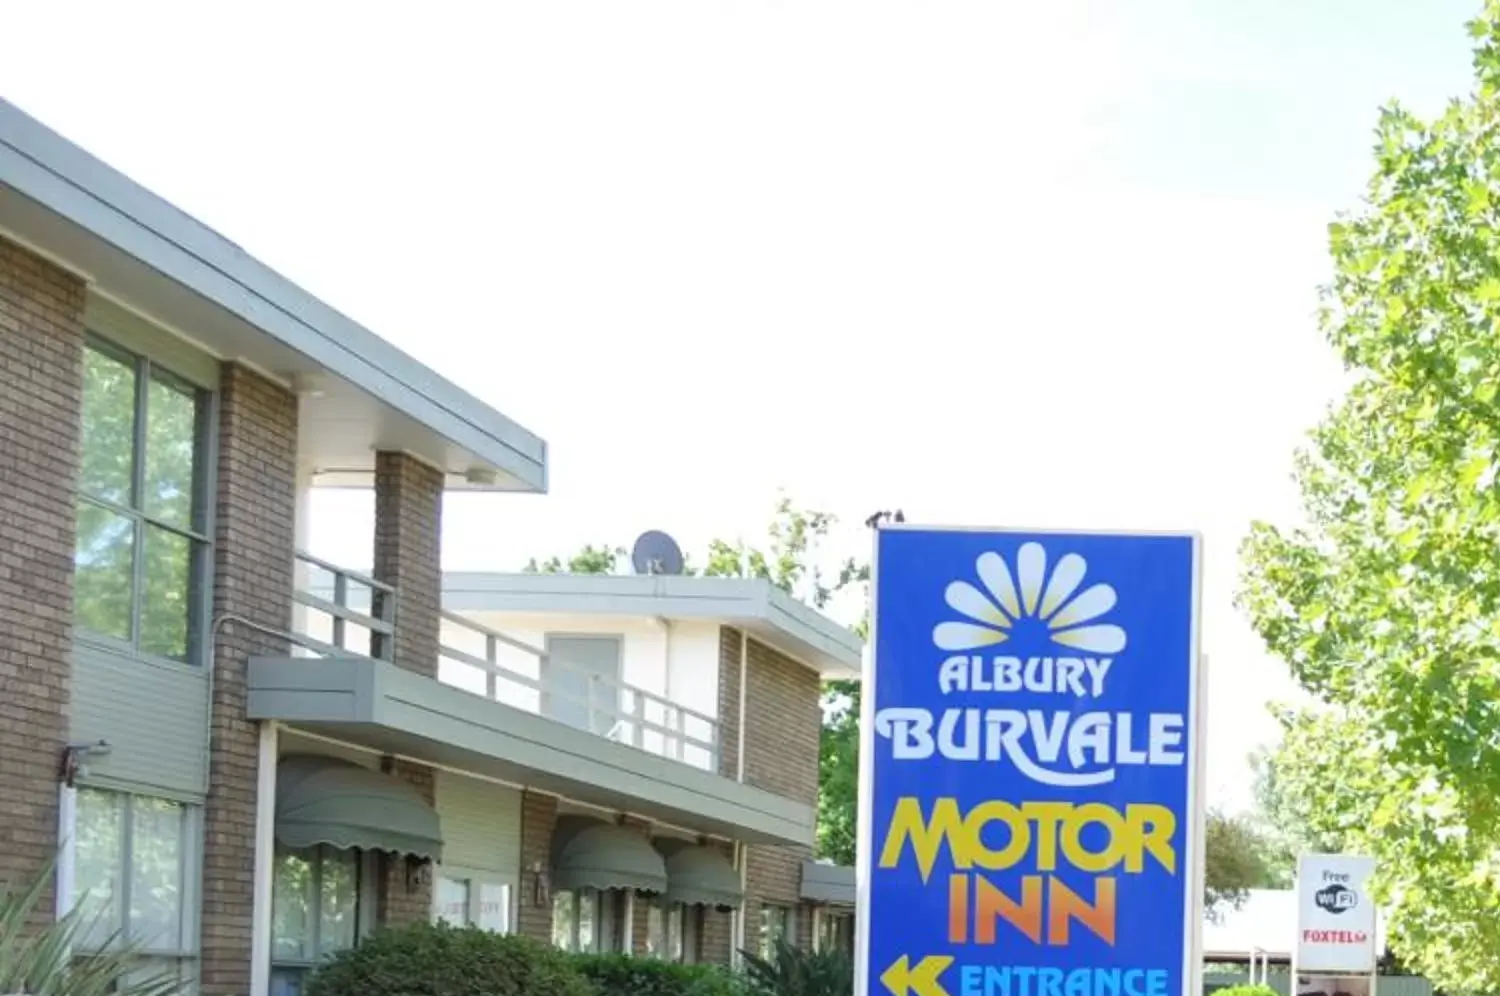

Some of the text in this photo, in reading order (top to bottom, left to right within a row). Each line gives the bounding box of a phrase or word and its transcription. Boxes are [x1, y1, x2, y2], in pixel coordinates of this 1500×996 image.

[939, 655, 1112, 698] ALBURY
[875, 707, 1185, 786] BURVALE
[879, 797, 1176, 886] MOTOR
[1322, 870, 1350, 882] Free
[948, 874, 1117, 946] INN
[1303, 930, 1354, 943] FOXTEL
